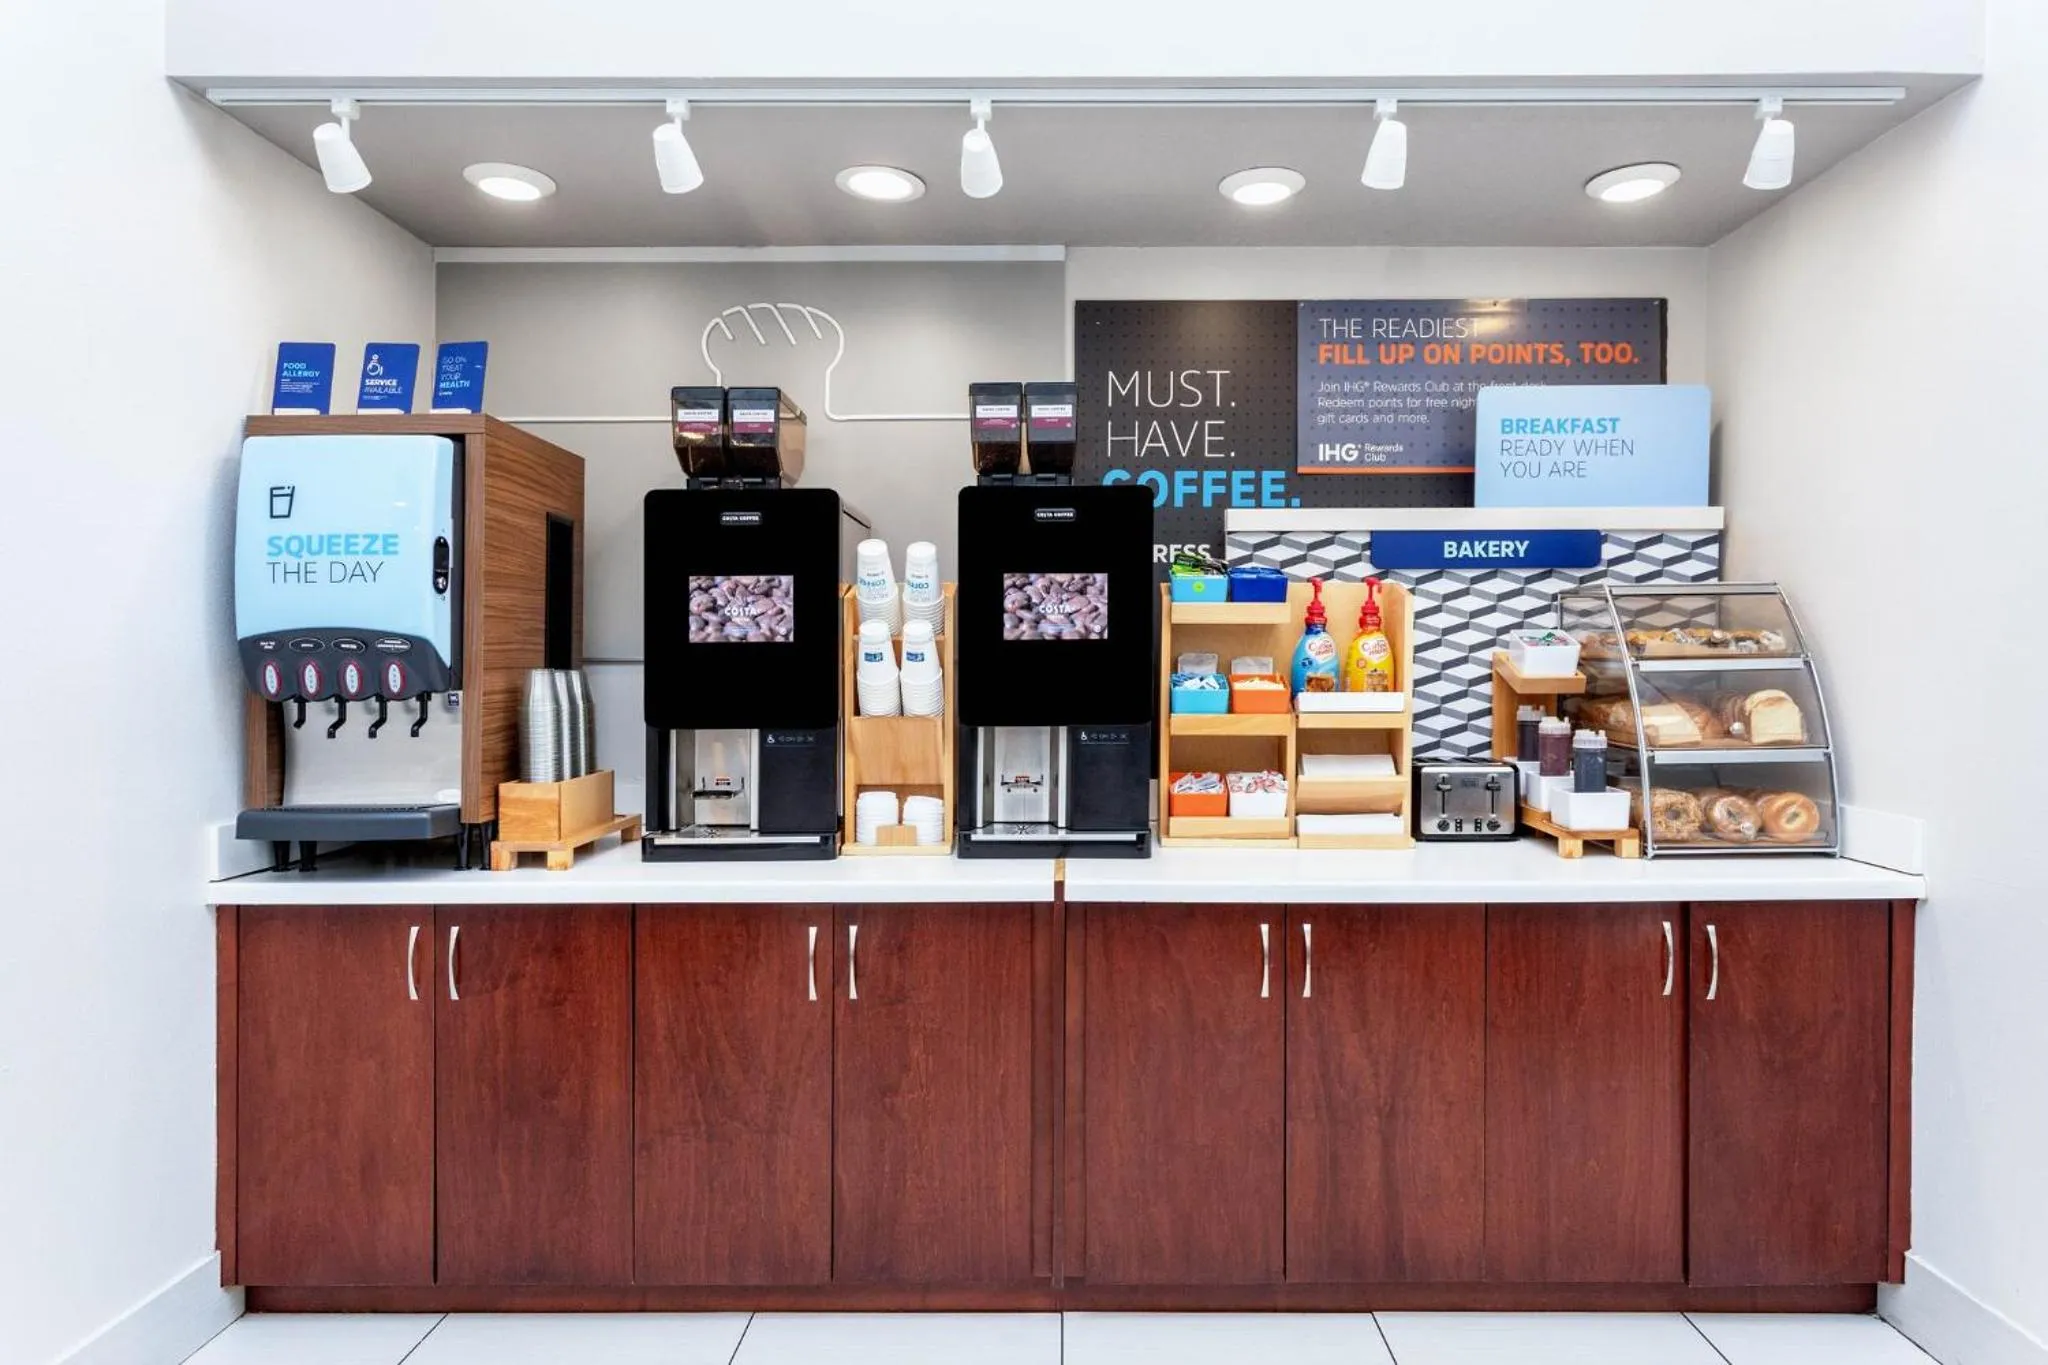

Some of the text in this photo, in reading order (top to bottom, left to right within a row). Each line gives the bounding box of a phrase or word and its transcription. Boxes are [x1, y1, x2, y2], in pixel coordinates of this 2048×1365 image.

[1319, 318, 1480, 338] THE READIEST
[1318, 342, 1640, 367] FILL UP ON POINTS, TOO.
[364, 378, 398, 386] SERVICE
[439, 380, 470, 388] HEALTH
[1108, 370, 1236, 408] MUST.
[1318, 381, 1340, 393] Join
[1374, 381, 1421, 393] Rewards
[1425, 381, 1449, 393] Club
[1453, 382, 1464, 393] at
[1318, 396, 1476, 411] Redeem points for free nigh
[1317, 412, 1430, 425] gift cards and more.
[1500, 417, 1620, 435] BREAKFAST
[1107, 420, 1236, 457] HAVE.
[1364, 443, 1404, 453] Rewards
[1500, 439, 1635, 457] READY WHEN
[1364, 453, 1387, 462] Club
[1500, 460, 1588, 478] YOU ARE
[266, 533, 399, 558] SQUEEZE
[1443, 540, 1530, 558] BAKERY
[266, 560, 384, 584] THE DAY
[724, 606, 757, 616] COSTA
[1039, 603, 1072, 614] COSTA
